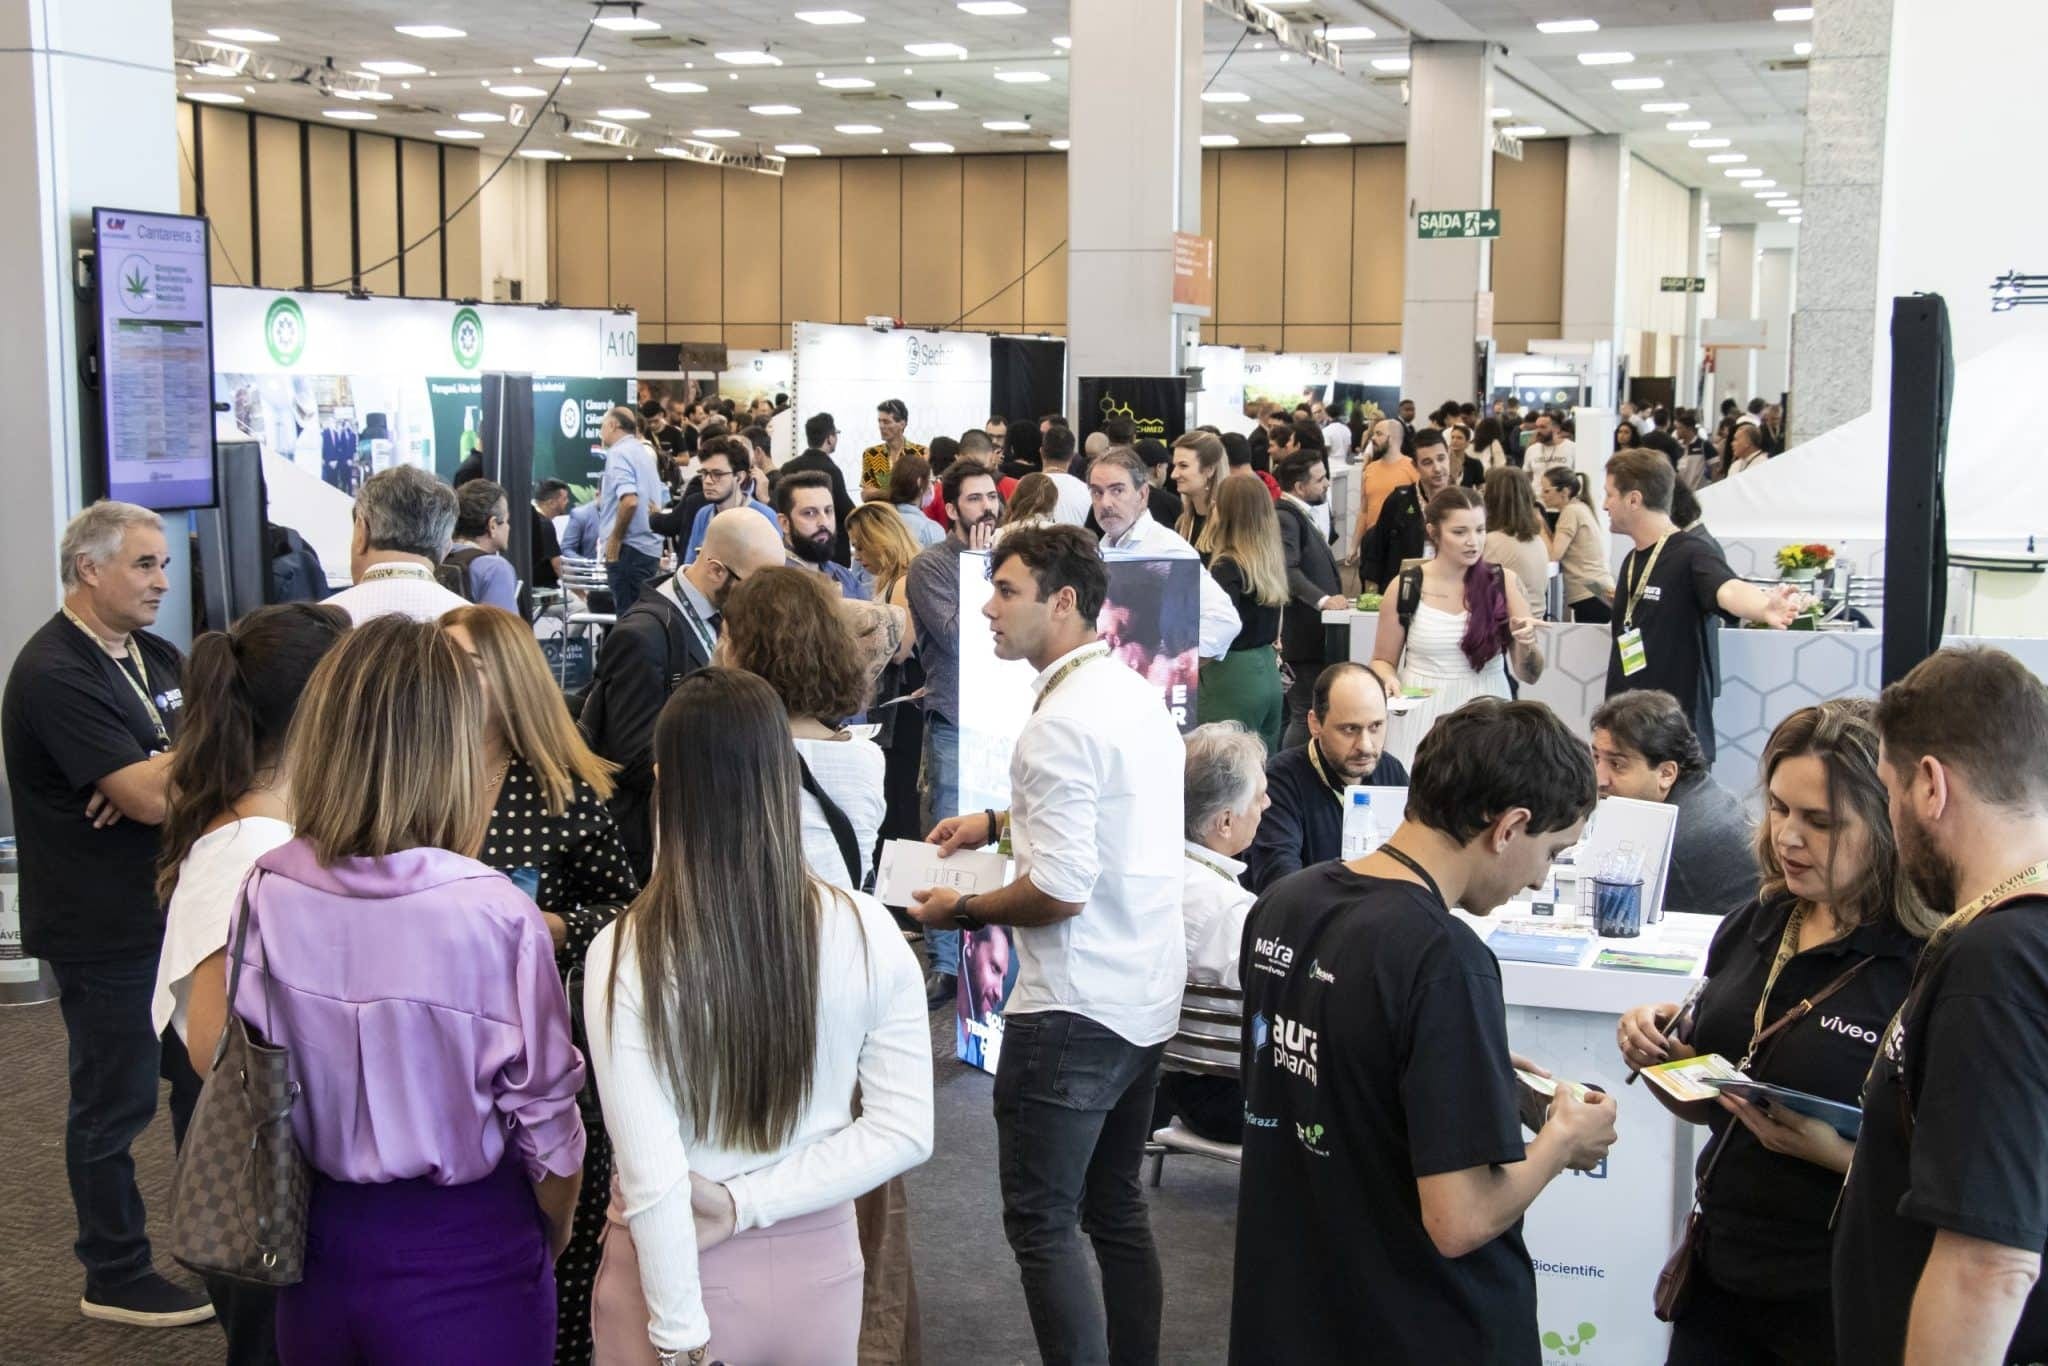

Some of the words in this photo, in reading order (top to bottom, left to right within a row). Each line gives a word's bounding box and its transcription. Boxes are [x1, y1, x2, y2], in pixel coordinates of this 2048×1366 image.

[195, 228, 201, 244] 3
[608, 330, 636, 357] A10
[1992, 866, 2037, 897] REVIVID
[1820, 1015, 1877, 1043] viveo
[1273, 1046, 1318, 1087] pharm
[1532, 1259, 1605, 1279] Biocientific
